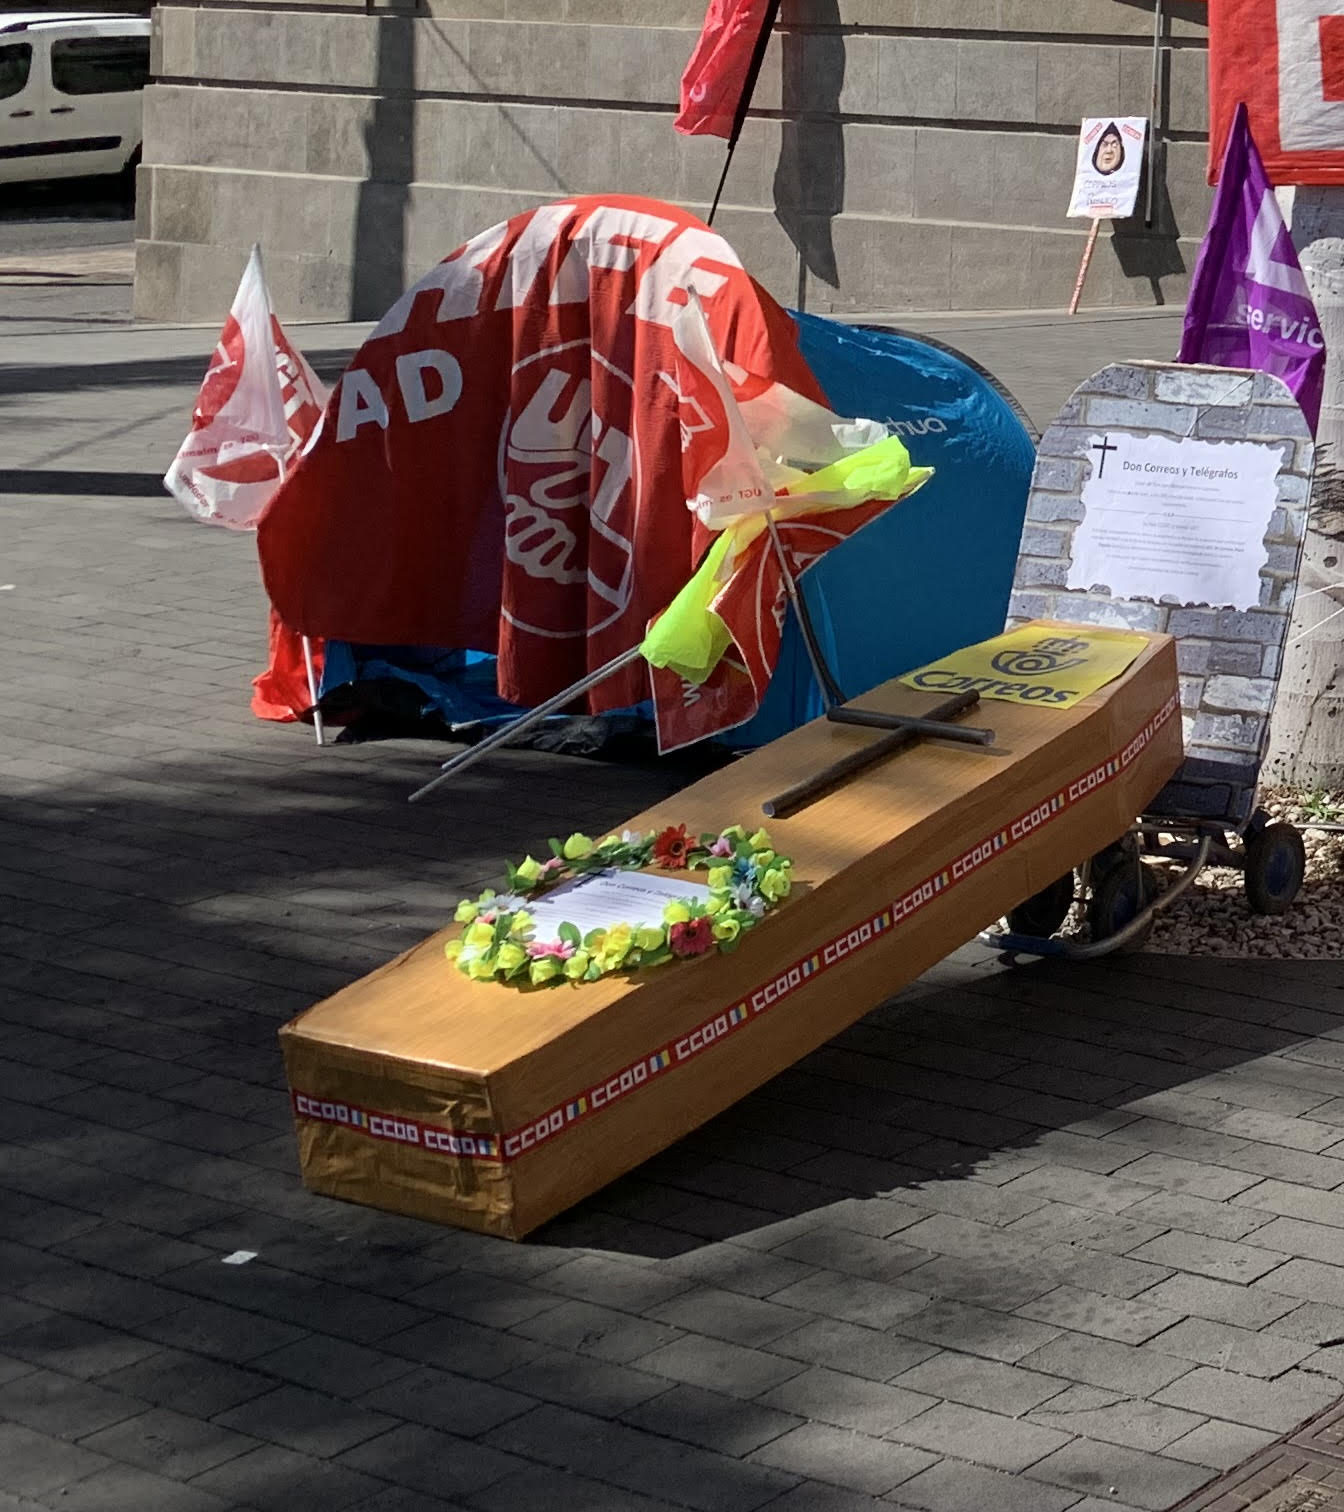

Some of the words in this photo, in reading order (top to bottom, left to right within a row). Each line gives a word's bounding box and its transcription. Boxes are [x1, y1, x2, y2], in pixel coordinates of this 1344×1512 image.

[1123, 460, 1142, 473] Don
[1144, 462, 1179, 476] Correos
[1181, 467, 1188, 478] y
[1190, 466, 1239, 480] Telégrafos
[912, 671, 1080, 704] Correos
